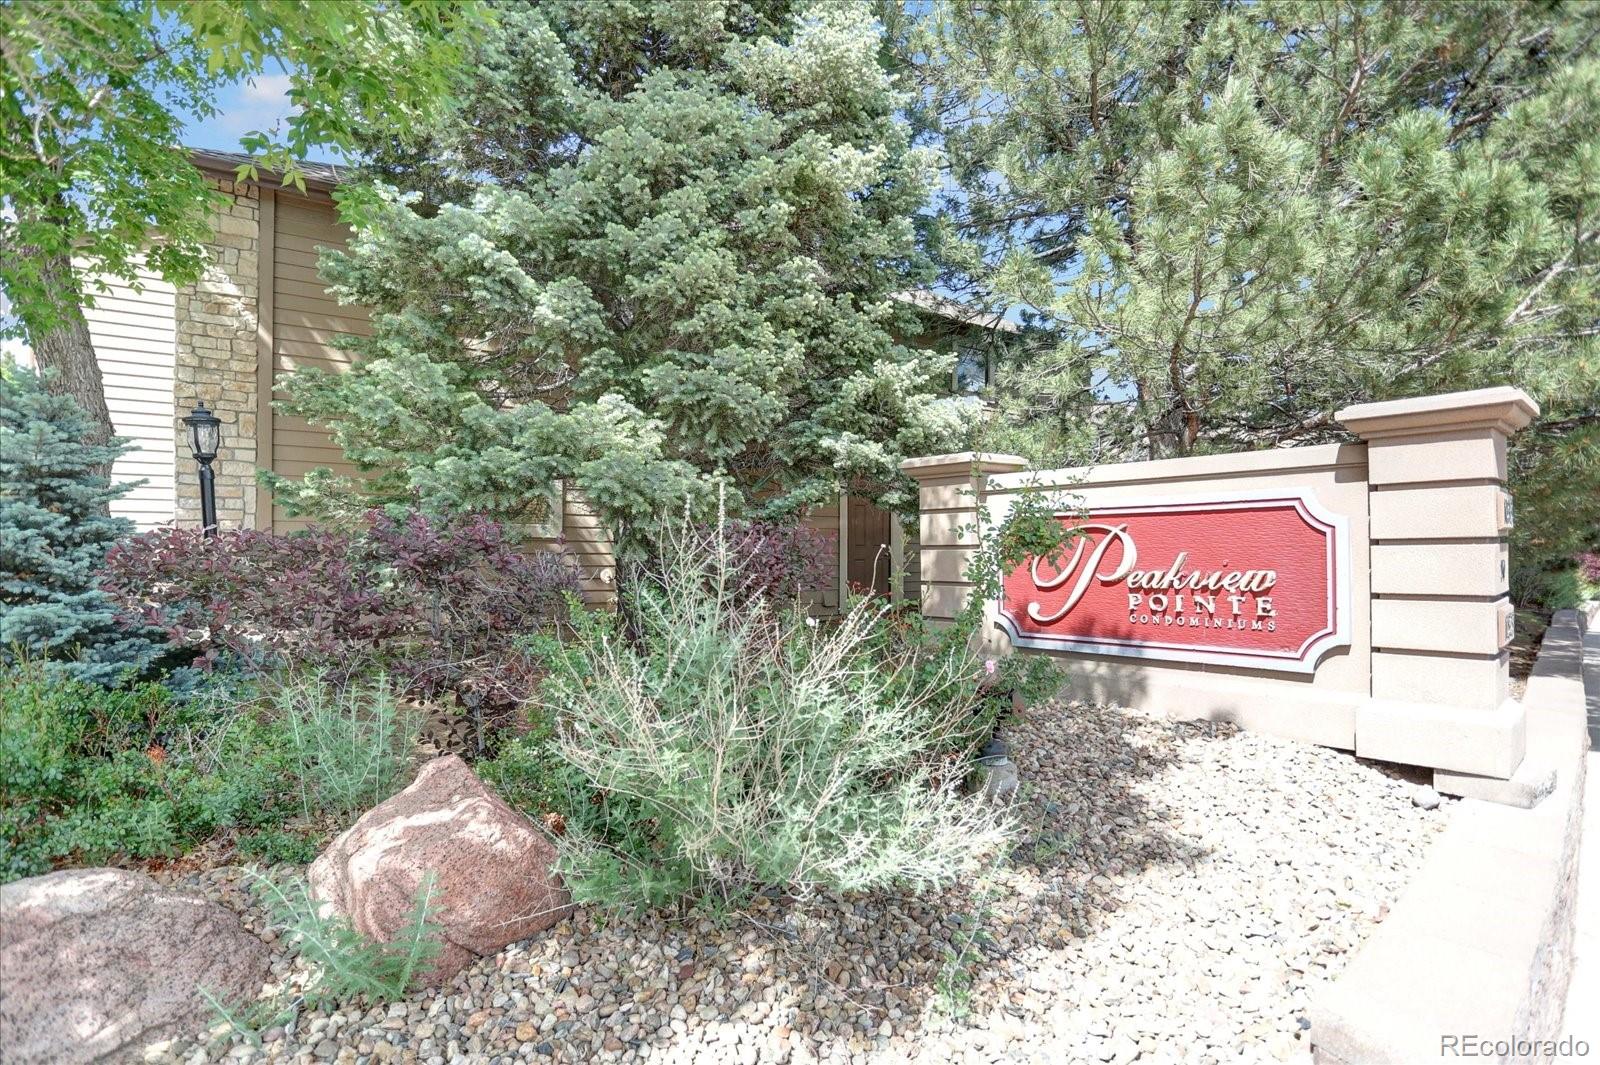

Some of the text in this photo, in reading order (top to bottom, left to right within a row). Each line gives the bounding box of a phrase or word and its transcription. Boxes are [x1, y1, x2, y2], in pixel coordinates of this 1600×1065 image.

[1027, 523, 1277, 623] Peakview
[1127, 592, 1277, 617] POINTE
[1128, 613, 1277, 632] CONDOMINIUMS
